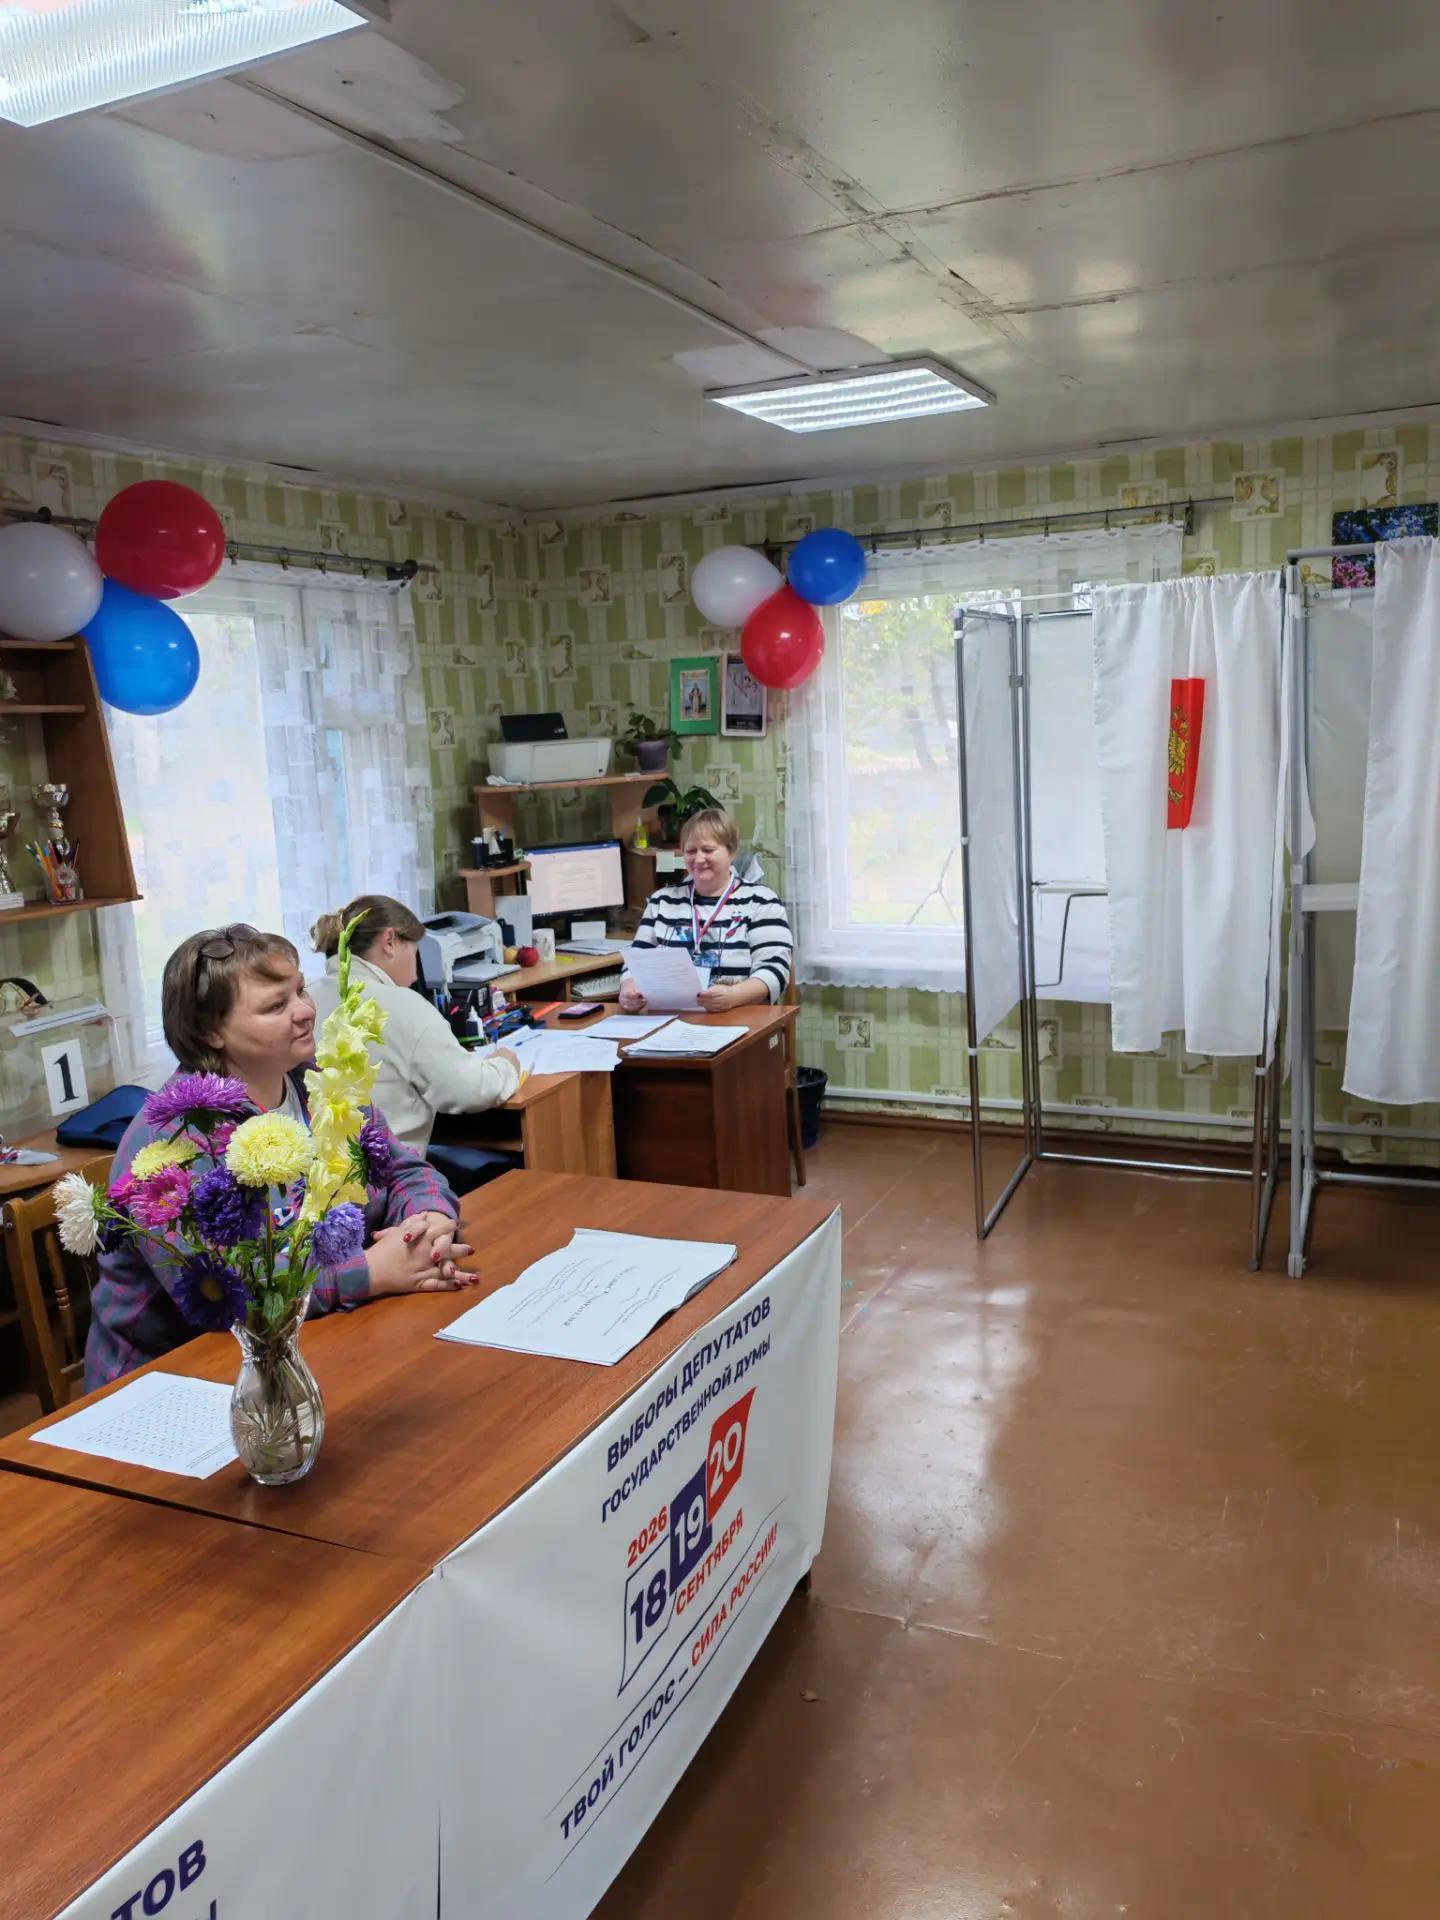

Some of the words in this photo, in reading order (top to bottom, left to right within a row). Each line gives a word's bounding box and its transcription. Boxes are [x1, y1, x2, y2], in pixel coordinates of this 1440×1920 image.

[53, 1053, 79, 1103] 1
[602, 1364, 732, 1523] ГОСУДАРСТВЕННОЙ
[734, 1334, 771, 1384] ДУМЫ
[607, 1375, 678, 1473] ВЫБОРЫ
[681, 1296, 771, 1394] ДЕПУТАТОВ
[627, 1506, 668, 1568] 2026
[630, 1568, 667, 1645] 18
[674, 1494, 705, 1565] 19
[709, 1421, 743, 1498] 20
[675, 1508, 743, 1617] СЕНТЯБРЯ
[560, 1752, 614, 1840] ТВОЙ
[618, 1679, 675, 1769] ГОЛОС
[691, 1604, 727, 1667] СИЛА
[730, 1521, 778, 1611] РОССИИ!
